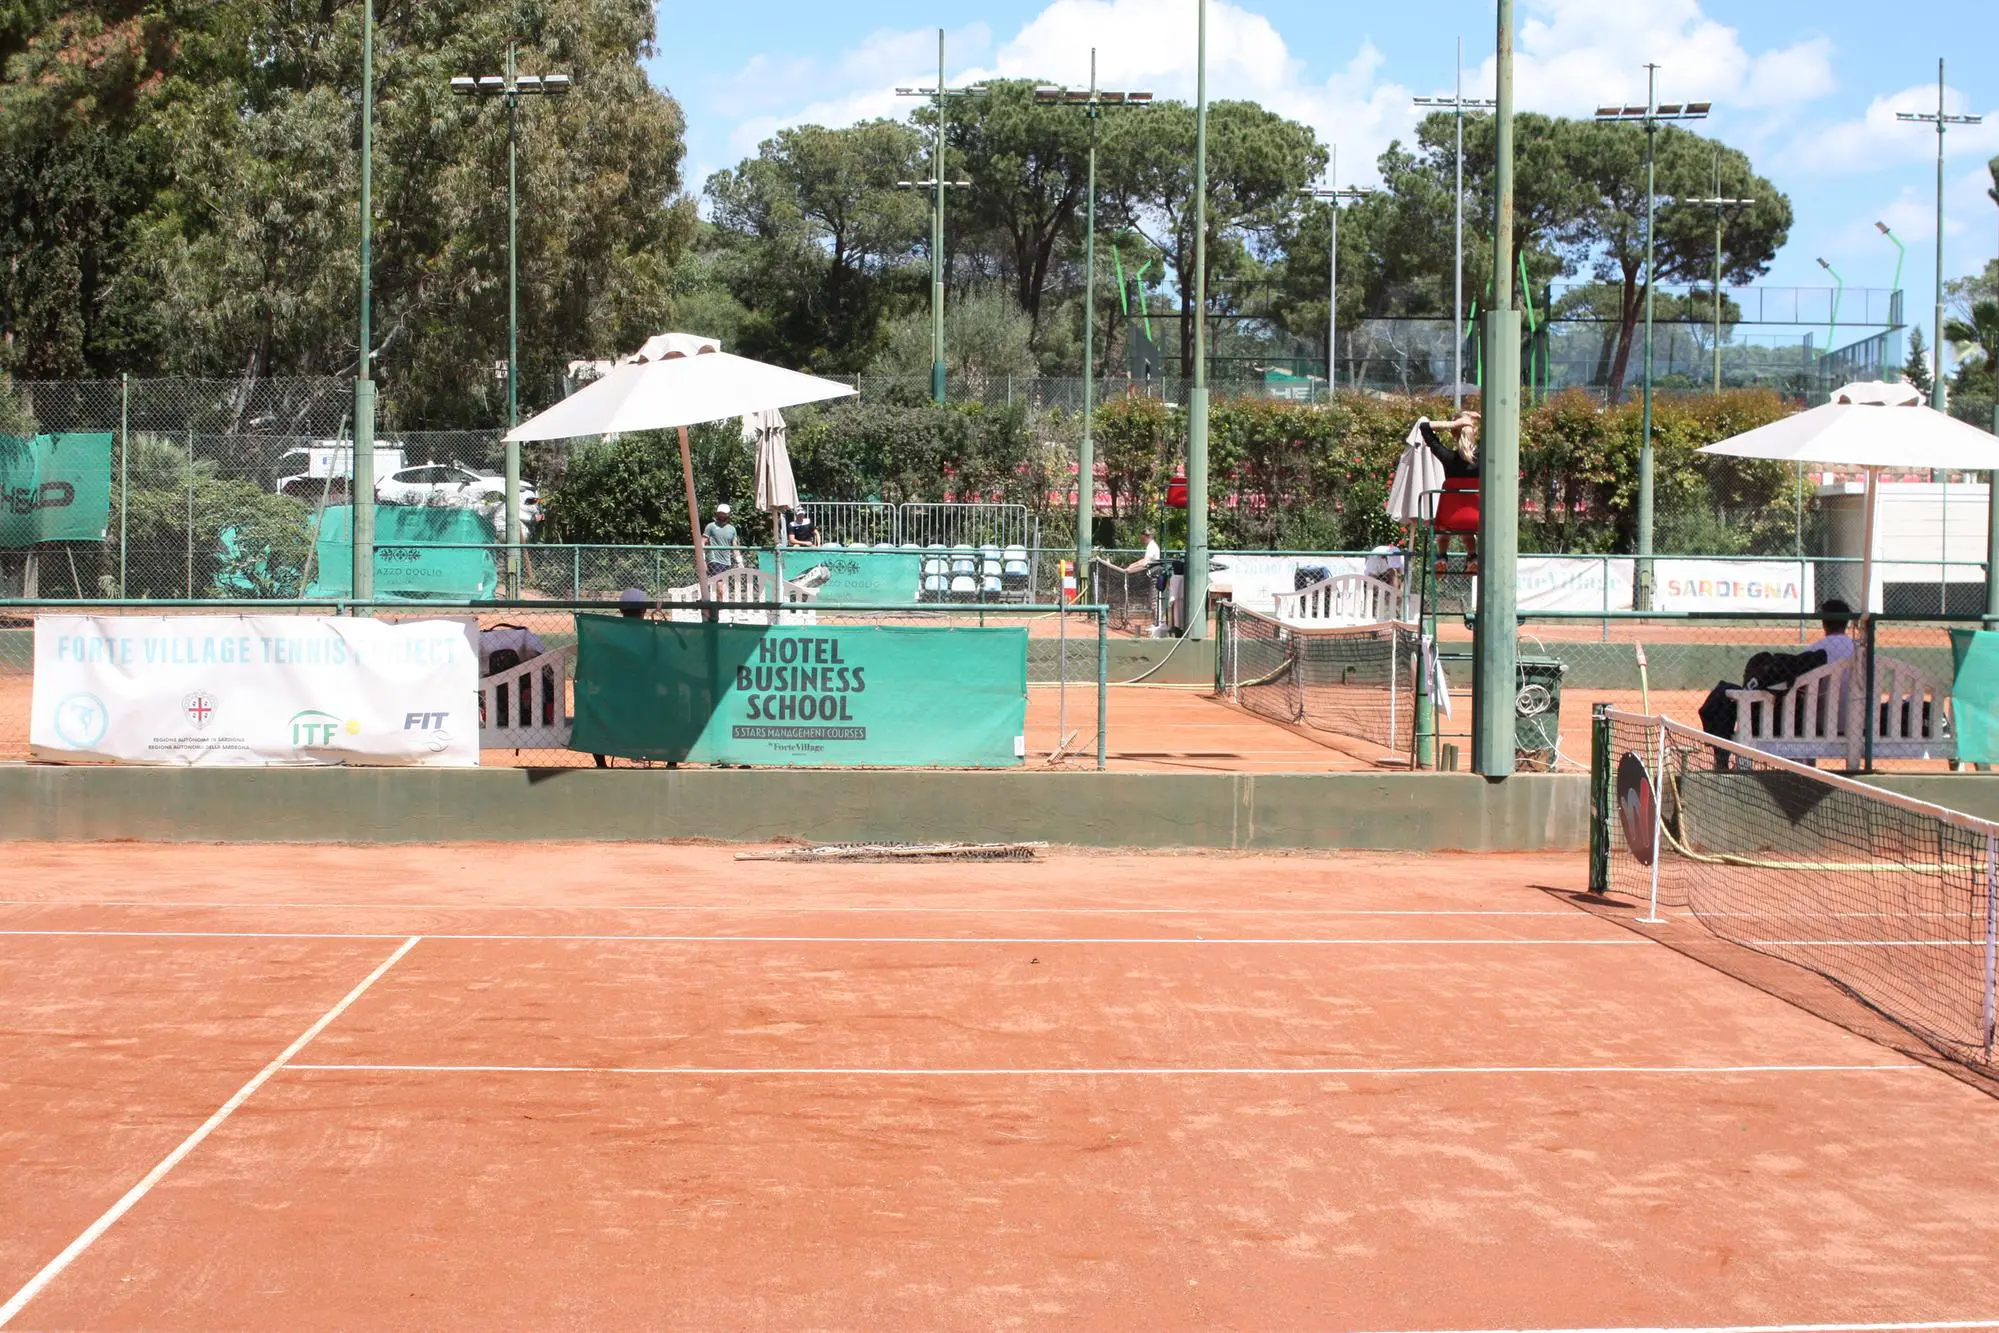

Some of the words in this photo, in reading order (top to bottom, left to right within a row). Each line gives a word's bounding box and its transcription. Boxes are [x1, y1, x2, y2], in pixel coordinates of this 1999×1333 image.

[1668, 579, 1798, 599] SARDEGNA
[58, 635, 133, 665] FORTE
[144, 636, 251, 664] VILLAGE
[261, 637, 346, 665] TENNIS
[353, 637, 457, 665] JECT
[759, 637, 845, 665] HOTEL
[736, 664, 866, 693] BUSINESS
[746, 693, 853, 721] SCHOOL
[403, 711, 450, 730] FIT
[293, 723, 338, 746] ITF
[734, 727, 741, 738] 5
[741, 728, 766, 738] STARS
[767, 728, 825, 740] MANAGEMENT
[827, 729, 864, 741] COURSES
